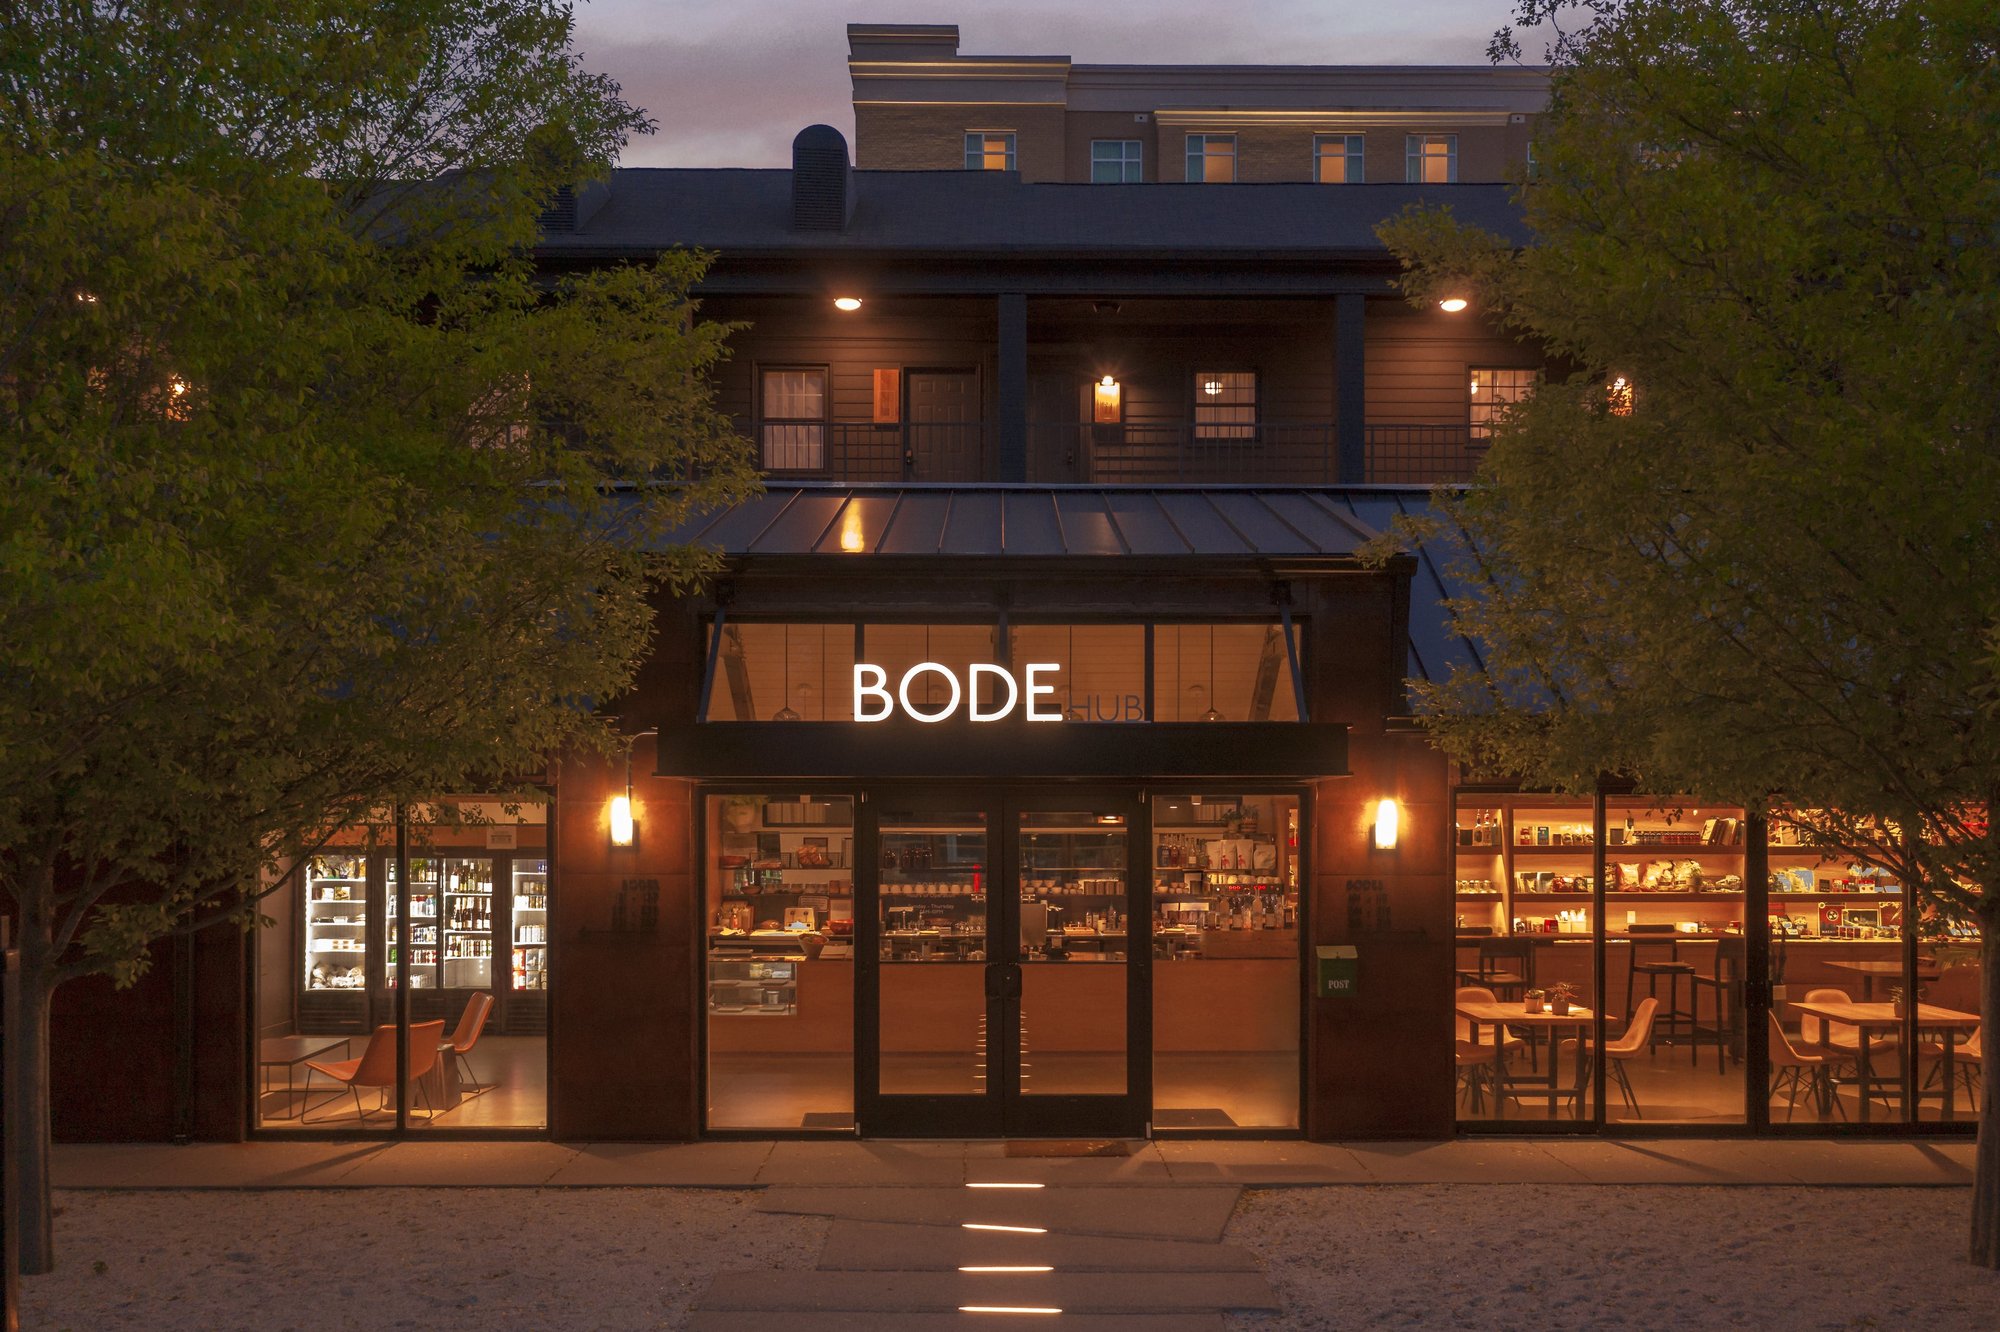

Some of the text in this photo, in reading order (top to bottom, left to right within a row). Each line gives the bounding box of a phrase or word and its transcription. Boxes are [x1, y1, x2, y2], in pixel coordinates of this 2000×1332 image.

[853, 661, 1144, 723] BODE HUB
[1328, 979, 1350, 989] POST
